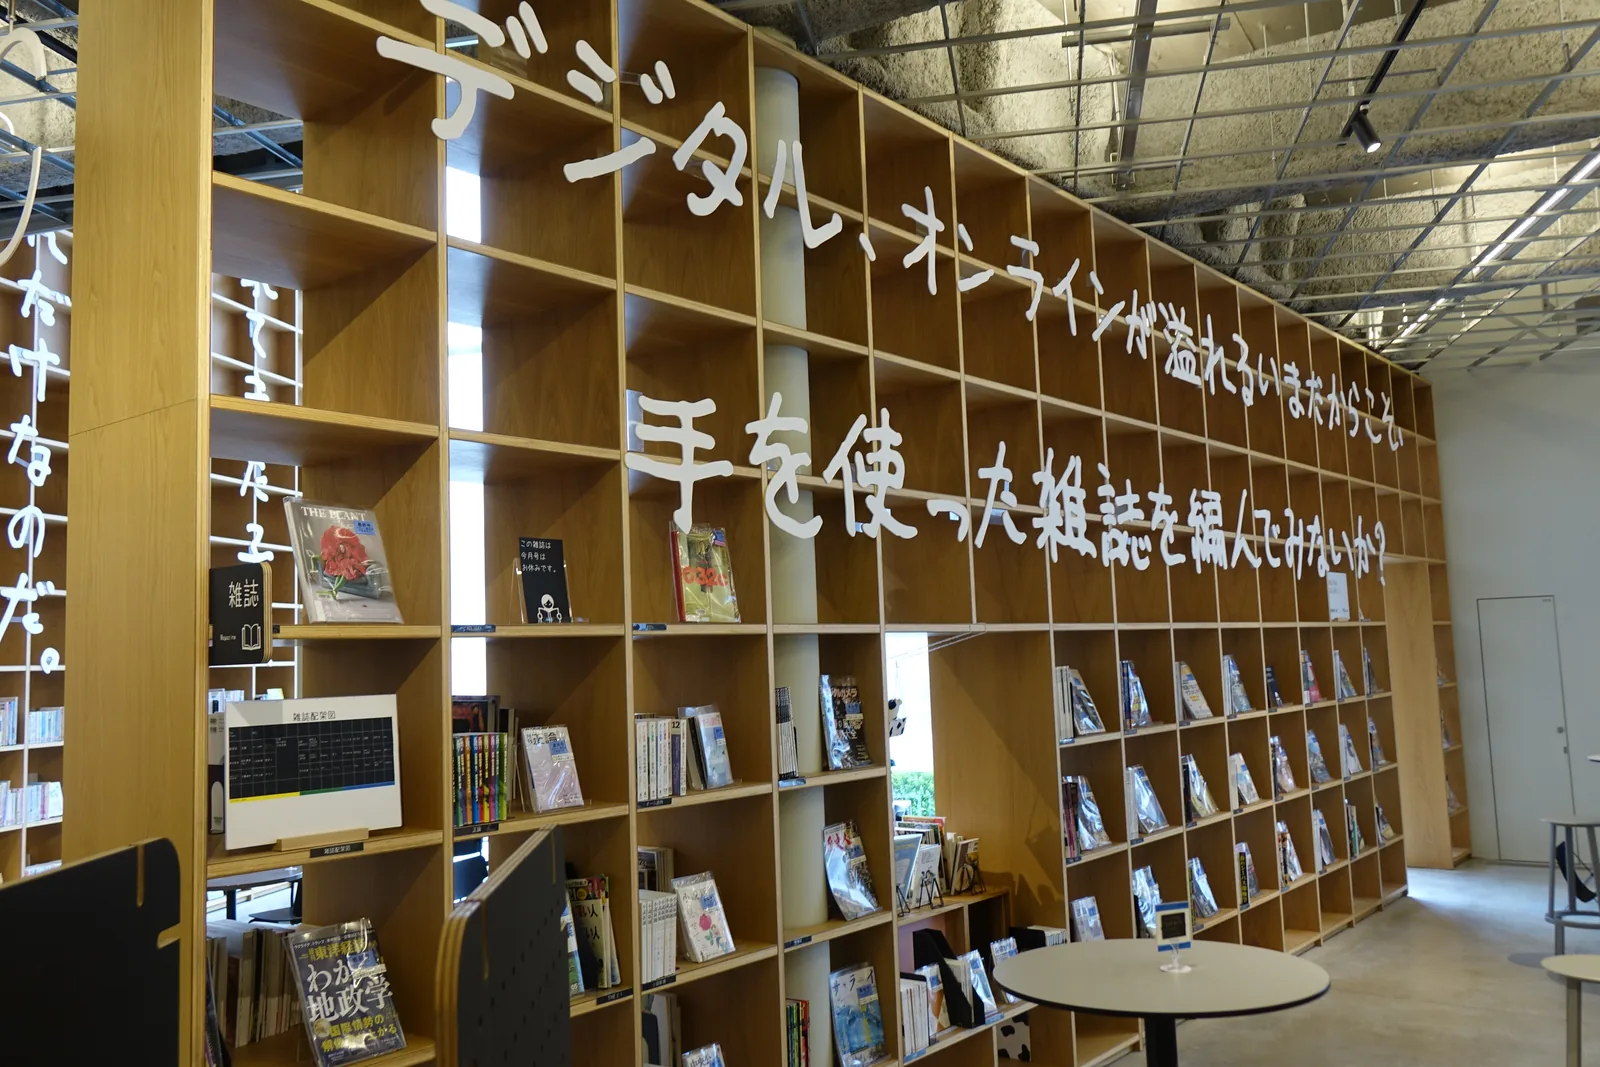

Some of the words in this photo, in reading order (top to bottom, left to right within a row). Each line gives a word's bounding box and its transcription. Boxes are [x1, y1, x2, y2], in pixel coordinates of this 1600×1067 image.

[520, 540, 552, 549] この雑誌は
[521, 551, 546, 560] 今月号は
[522, 564, 557, 573] お休みです。
[228, 578, 259, 608] 雑誌
[672, 721, 680, 729] 12
[306, 976, 393, 1022] 地政学
